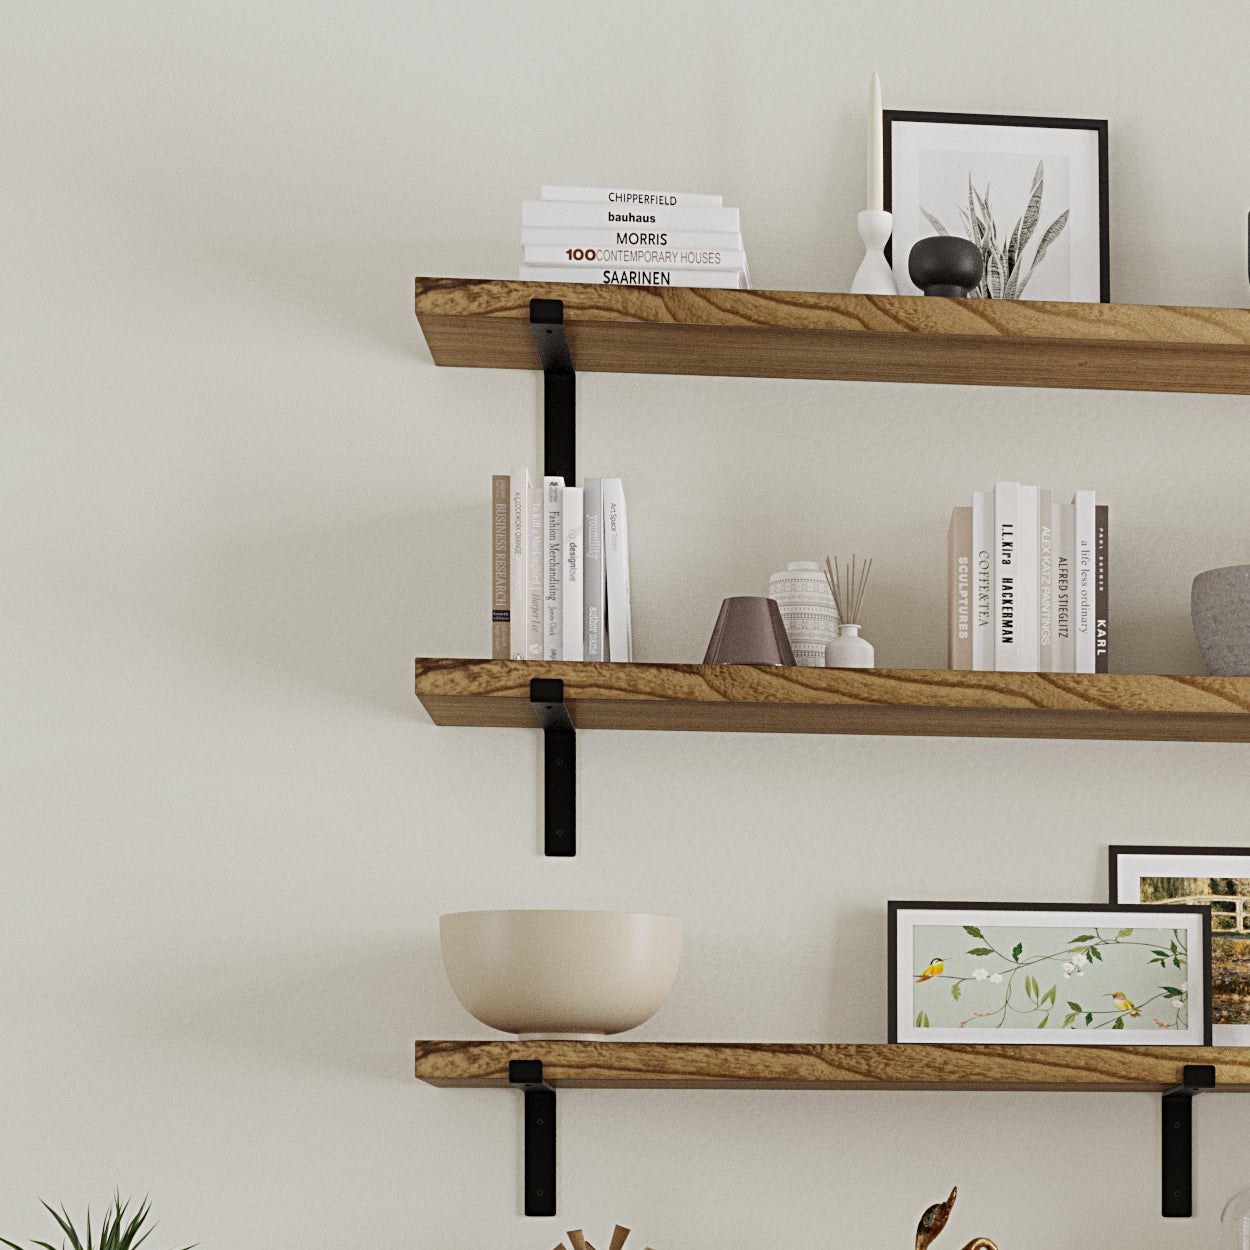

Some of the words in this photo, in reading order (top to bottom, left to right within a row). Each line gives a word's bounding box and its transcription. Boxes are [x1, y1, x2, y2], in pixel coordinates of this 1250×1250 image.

[608, 192, 677, 206] CHIPPERFIELD
[608, 211, 656, 223] bauhaus
[616, 232, 668, 246] MORRIS
[680, 251, 721, 264] HOUSES
[603, 270, 670, 285] SAARINEN
[495, 503, 507, 551] BUSINESS
[514, 497, 522, 530] CLOCKWORK
[532, 513, 542, 528] Kill
[549, 511, 560, 541] Fashion
[514, 531, 522, 554] ORANGE
[1041, 526, 1051, 553] ALEX
[531, 536, 543, 584] Mockingbird
[546, 544, 560, 601] Merchandising
[1041, 556, 1050, 584] KATZ
[1081, 550, 1090, 566] life
[495, 553, 507, 606] RESEARCH
[1058, 556, 1068, 591] ALFRED
[1081, 569, 1090, 587] less
[958, 556, 968, 639] SCULPTURES
[979, 550, 989, 627] COFFE&TEA
[530, 594, 542, 620] Harper
[589, 607, 599, 632] author
[1001, 578, 1013, 644] HACKERMAN
[1041, 587, 1050, 645] PAINTINGS
[1058, 594, 1068, 638] STIEGLITZ
[1078, 589, 1090, 634] ordinary
[589, 634, 598, 655] name
[1097, 619, 1107, 656] KARL
